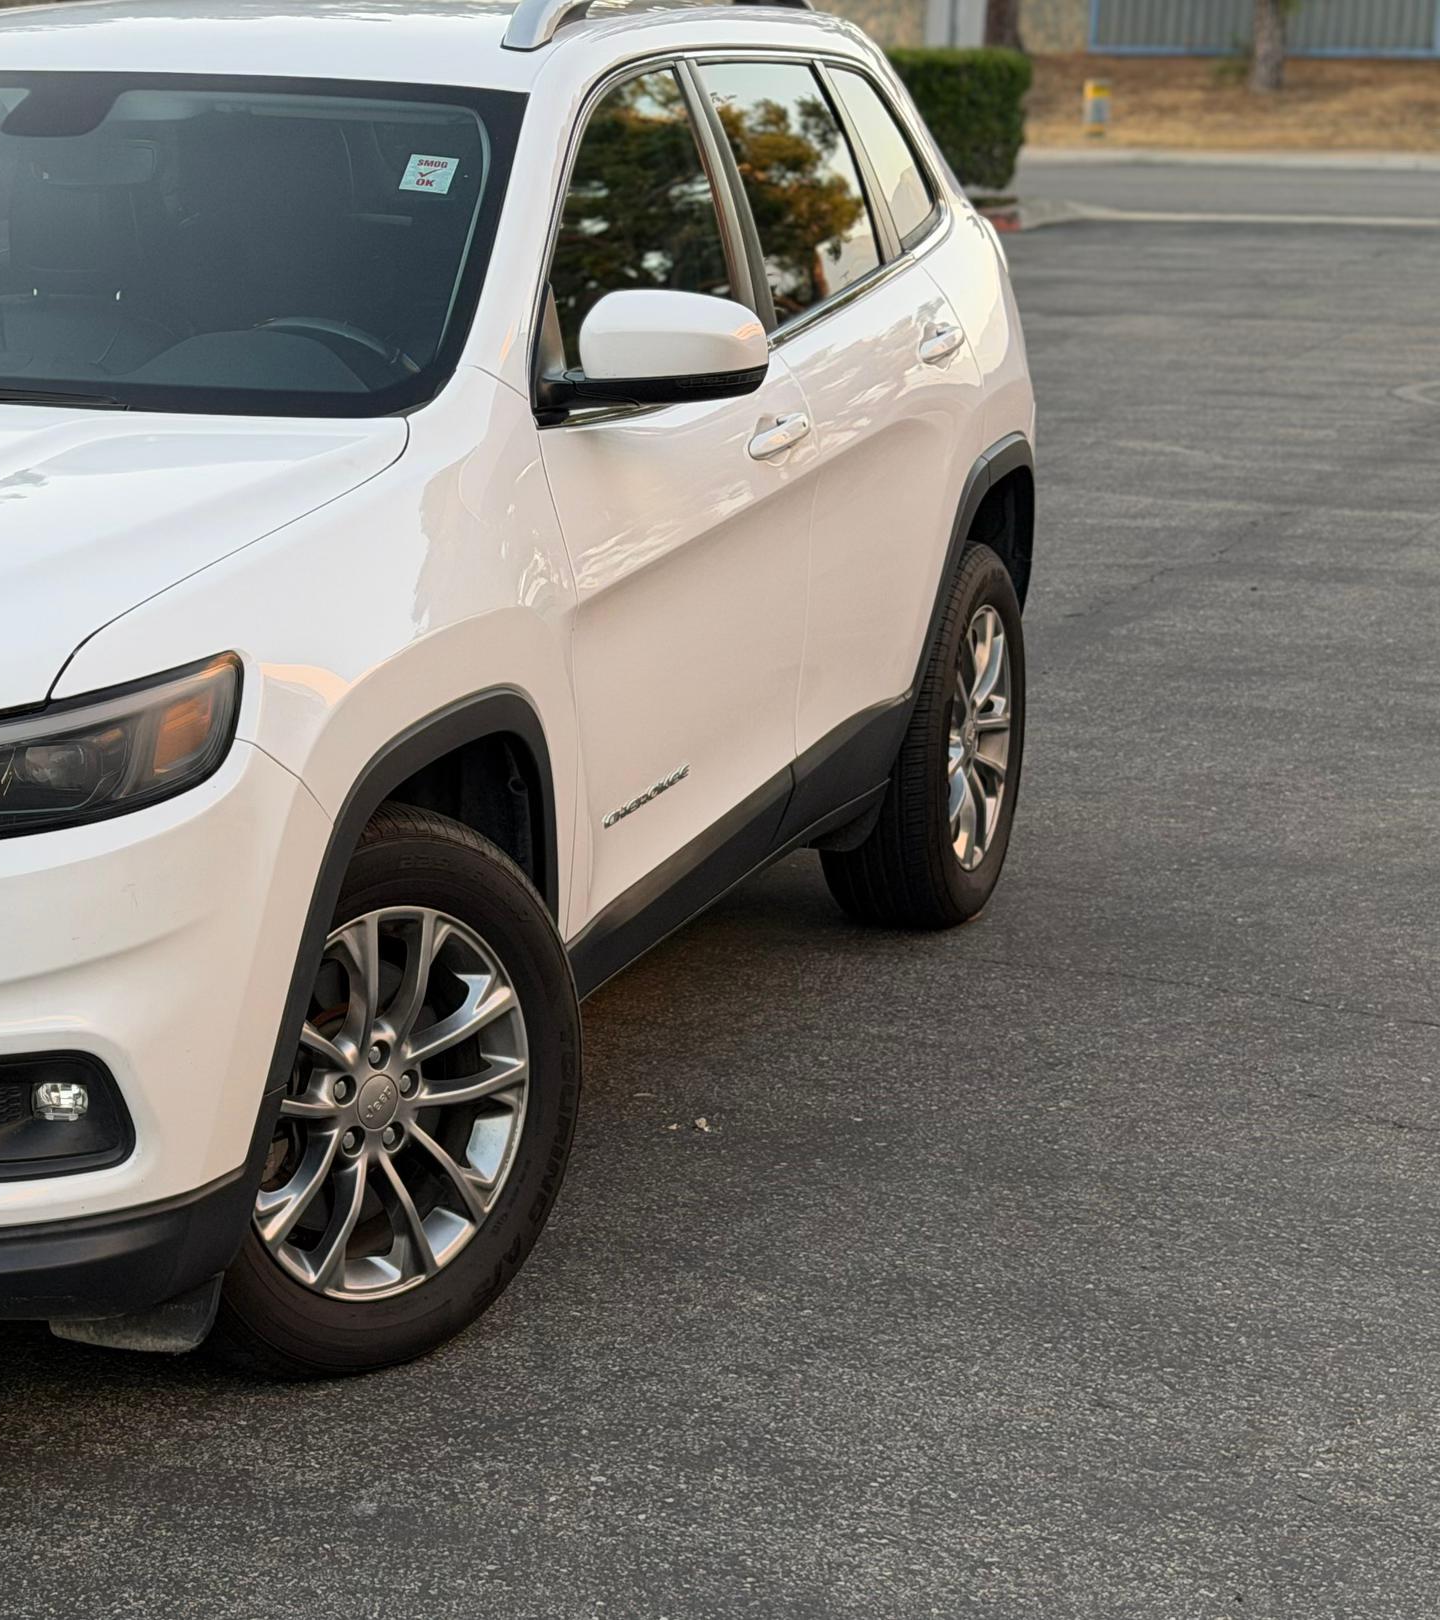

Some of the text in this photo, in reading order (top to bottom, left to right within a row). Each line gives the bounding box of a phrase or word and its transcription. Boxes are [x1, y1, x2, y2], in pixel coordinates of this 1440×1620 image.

[417, 159, 448, 168] SMOG
[416, 178, 435, 186] OK
[366, 1086, 392, 1119] Jeep
